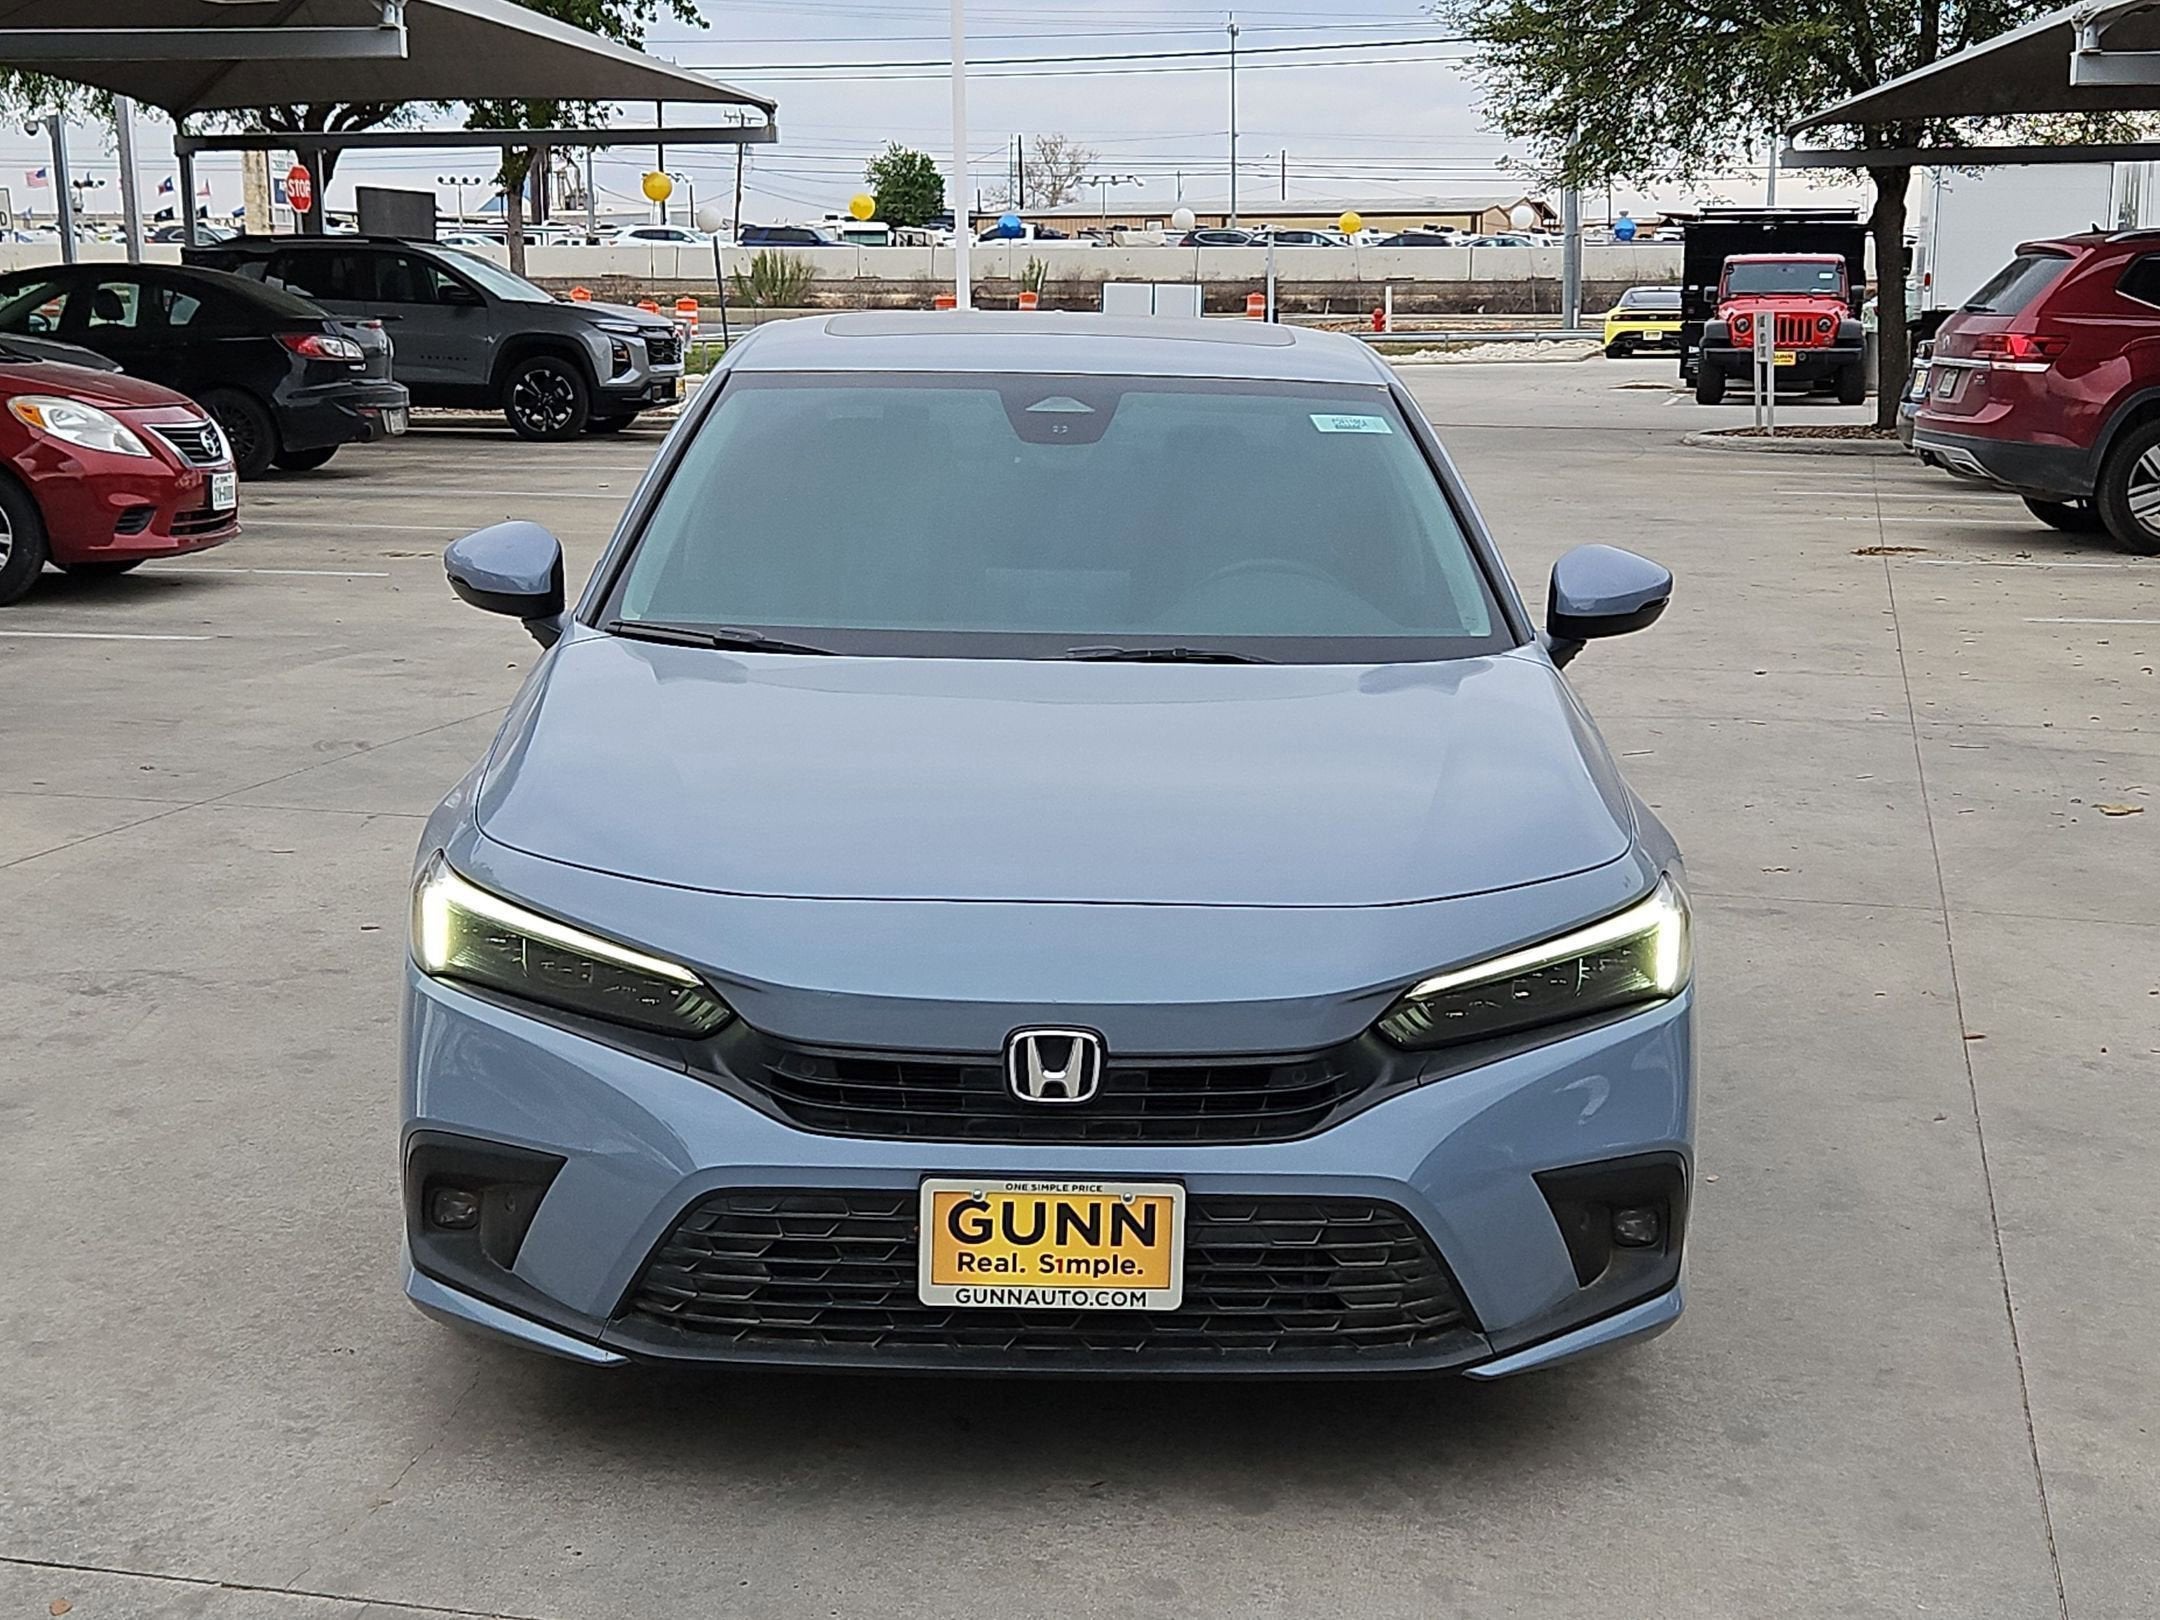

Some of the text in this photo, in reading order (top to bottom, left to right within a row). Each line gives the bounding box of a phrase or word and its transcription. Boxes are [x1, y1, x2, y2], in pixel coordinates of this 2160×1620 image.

[288, 179, 311, 198] STOP
[1005, 1183, 1103, 1192] ONE SIMPLE PRICE
[947, 1199, 1157, 1247] GUNN
[957, 1251, 1026, 1273] Real.
[955, 1288, 1147, 1308] GUNNAUTO.COM
